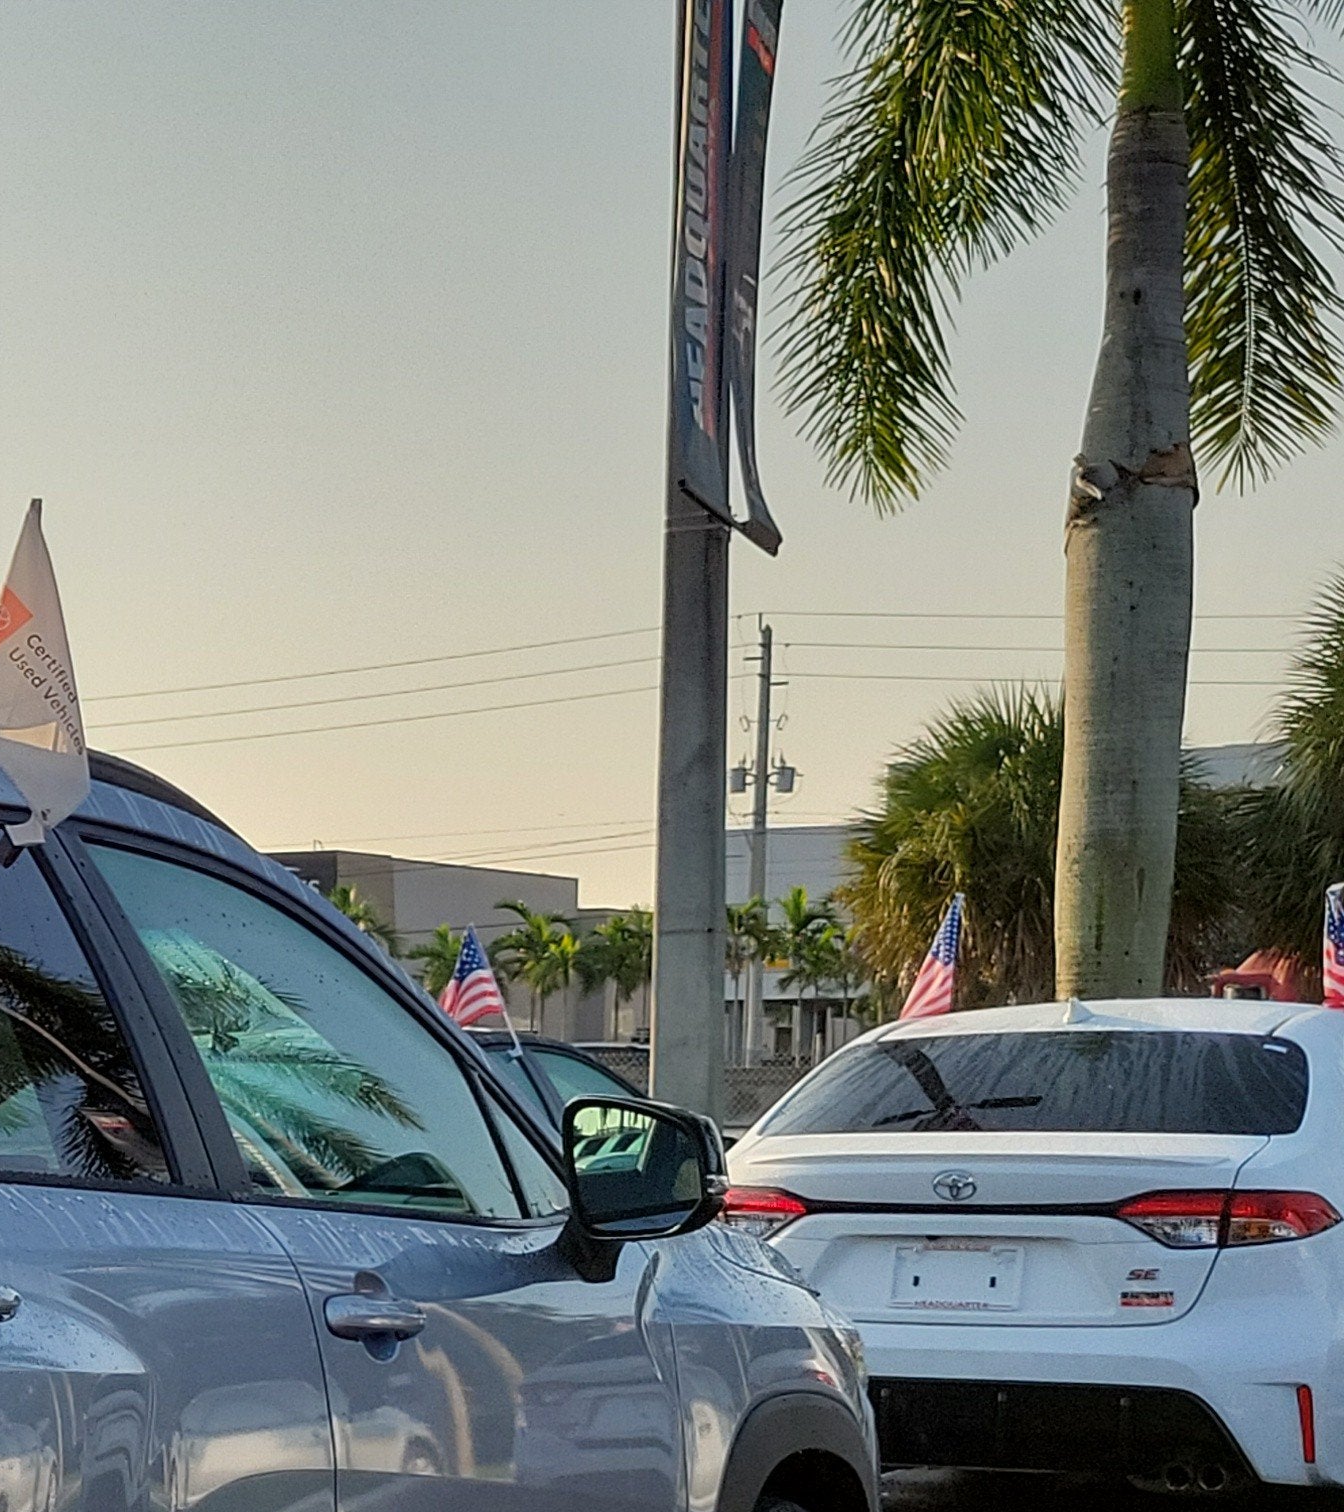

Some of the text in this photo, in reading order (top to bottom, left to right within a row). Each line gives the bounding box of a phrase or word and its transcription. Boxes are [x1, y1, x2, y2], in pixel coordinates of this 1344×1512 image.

[9, 647, 83, 756] Used Vehicles
[27, 634, 78, 704] Certified
[1126, 1268, 1160, 1281] SE
